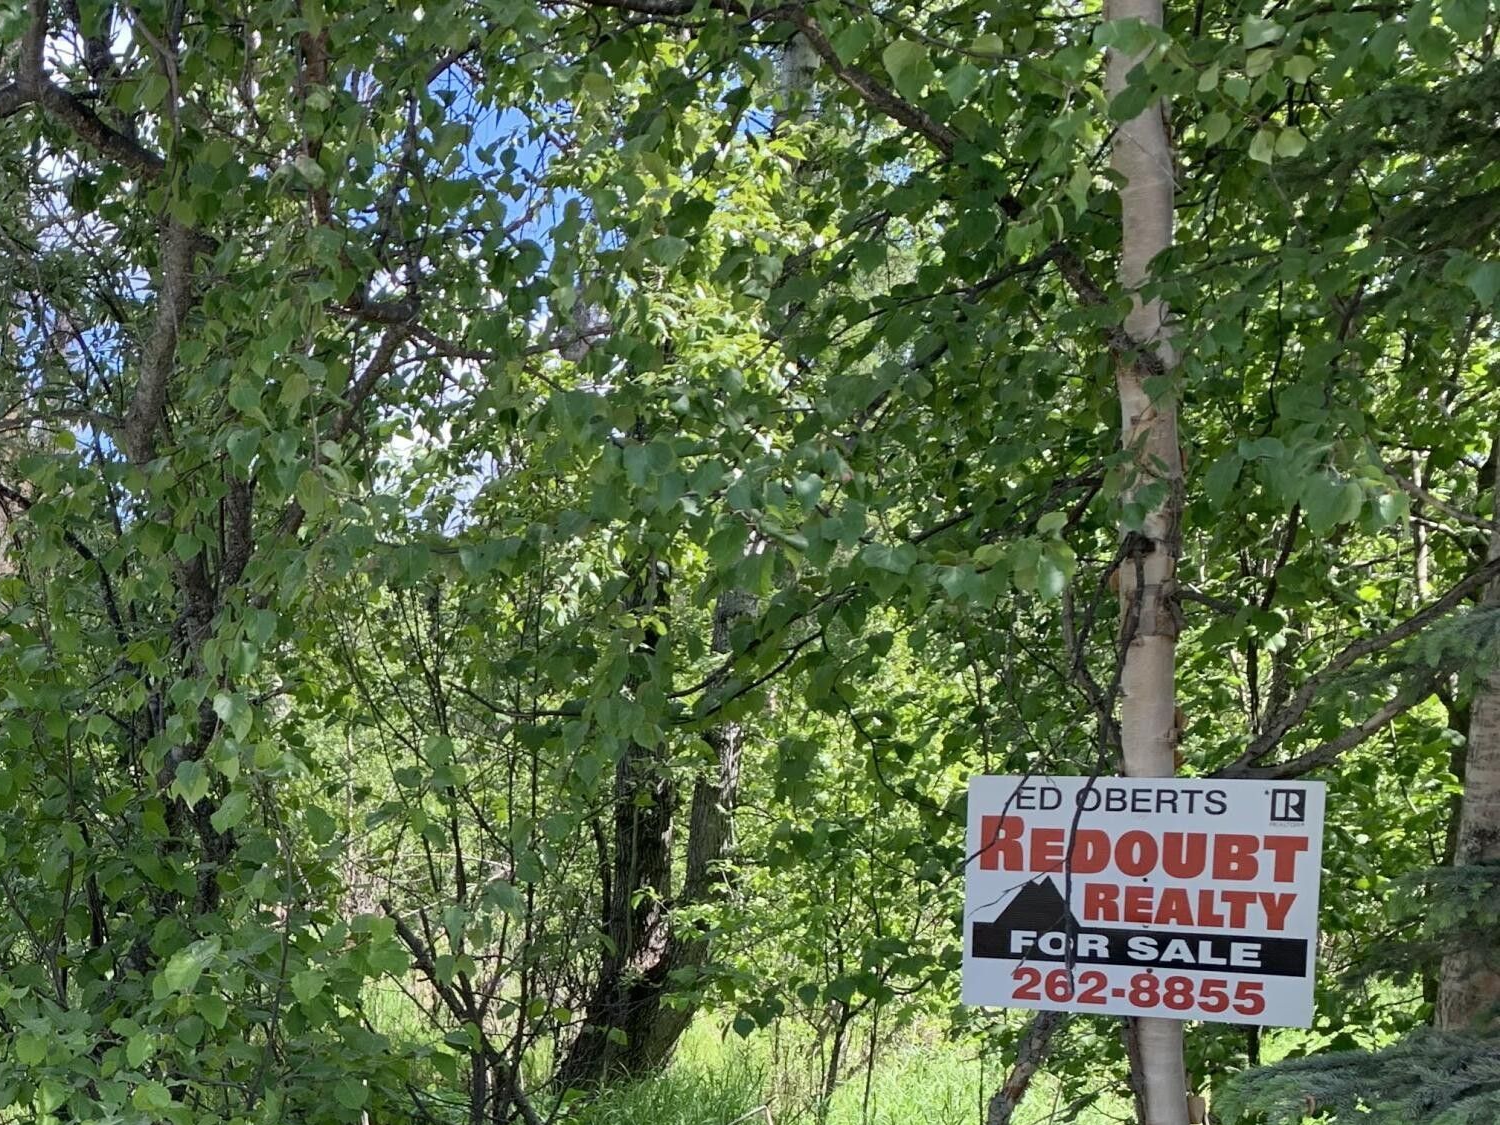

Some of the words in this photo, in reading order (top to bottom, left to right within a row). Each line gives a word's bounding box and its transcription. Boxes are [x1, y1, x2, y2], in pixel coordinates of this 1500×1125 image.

[1016, 786, 1062, 811] ED
[1075, 787, 1228, 815] OBERTS
[979, 815, 1309, 883] REDOUBT
[1084, 883, 1298, 931] REALTY
[1010, 930, 1109, 958] FOR
[1127, 936, 1262, 968] SALE
[1011, 966, 1266, 1016] 262-8855
